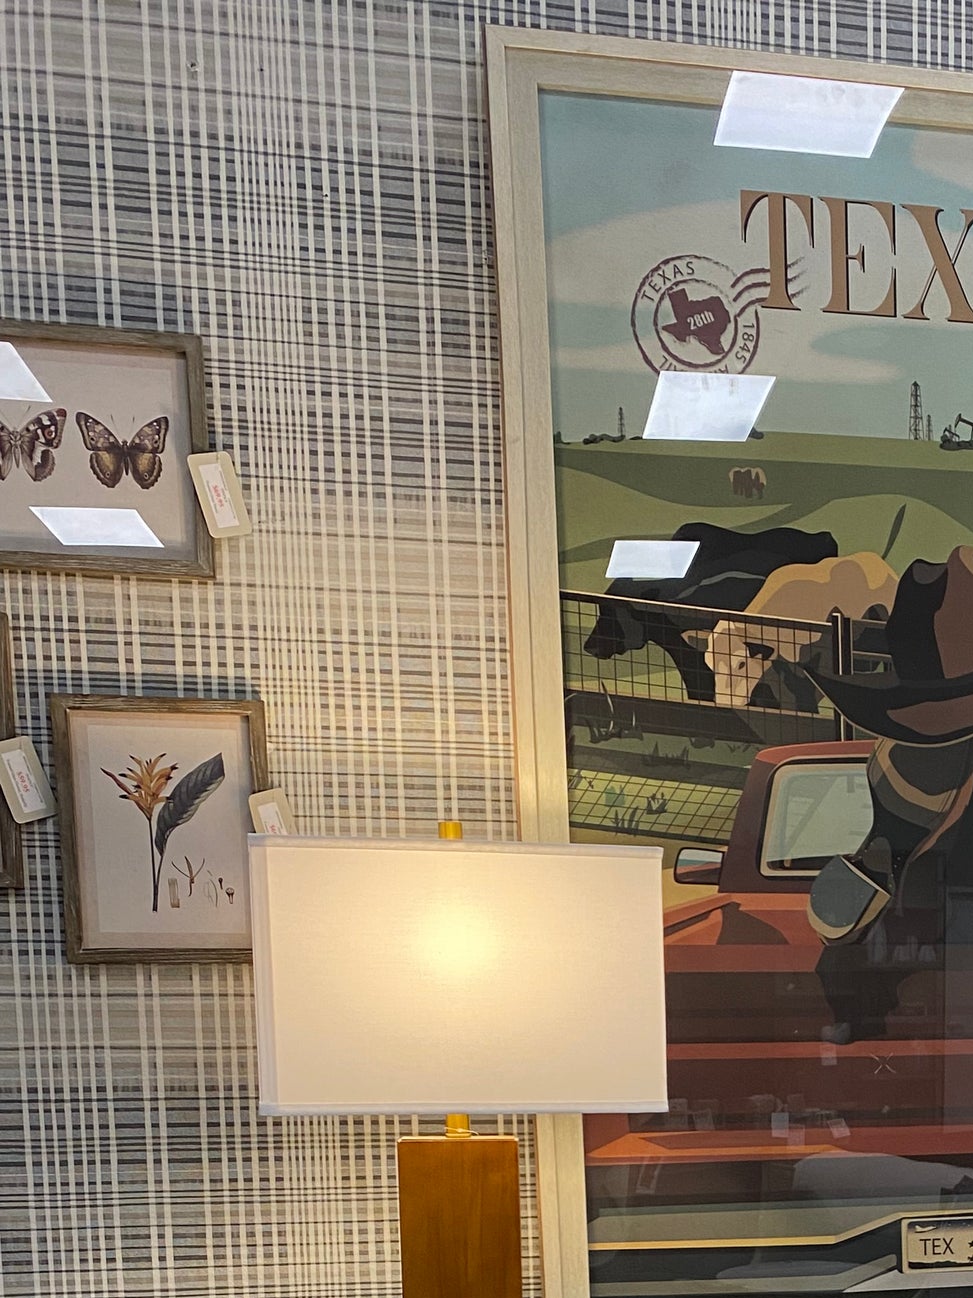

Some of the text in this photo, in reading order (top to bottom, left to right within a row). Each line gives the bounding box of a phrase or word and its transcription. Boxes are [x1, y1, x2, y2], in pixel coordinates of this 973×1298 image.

[641, 261, 695, 302] TEXAS
[687, 310, 714, 330] 28th
[735, 323, 755, 364] 1845
[919, 1237, 954, 1256] TEX
